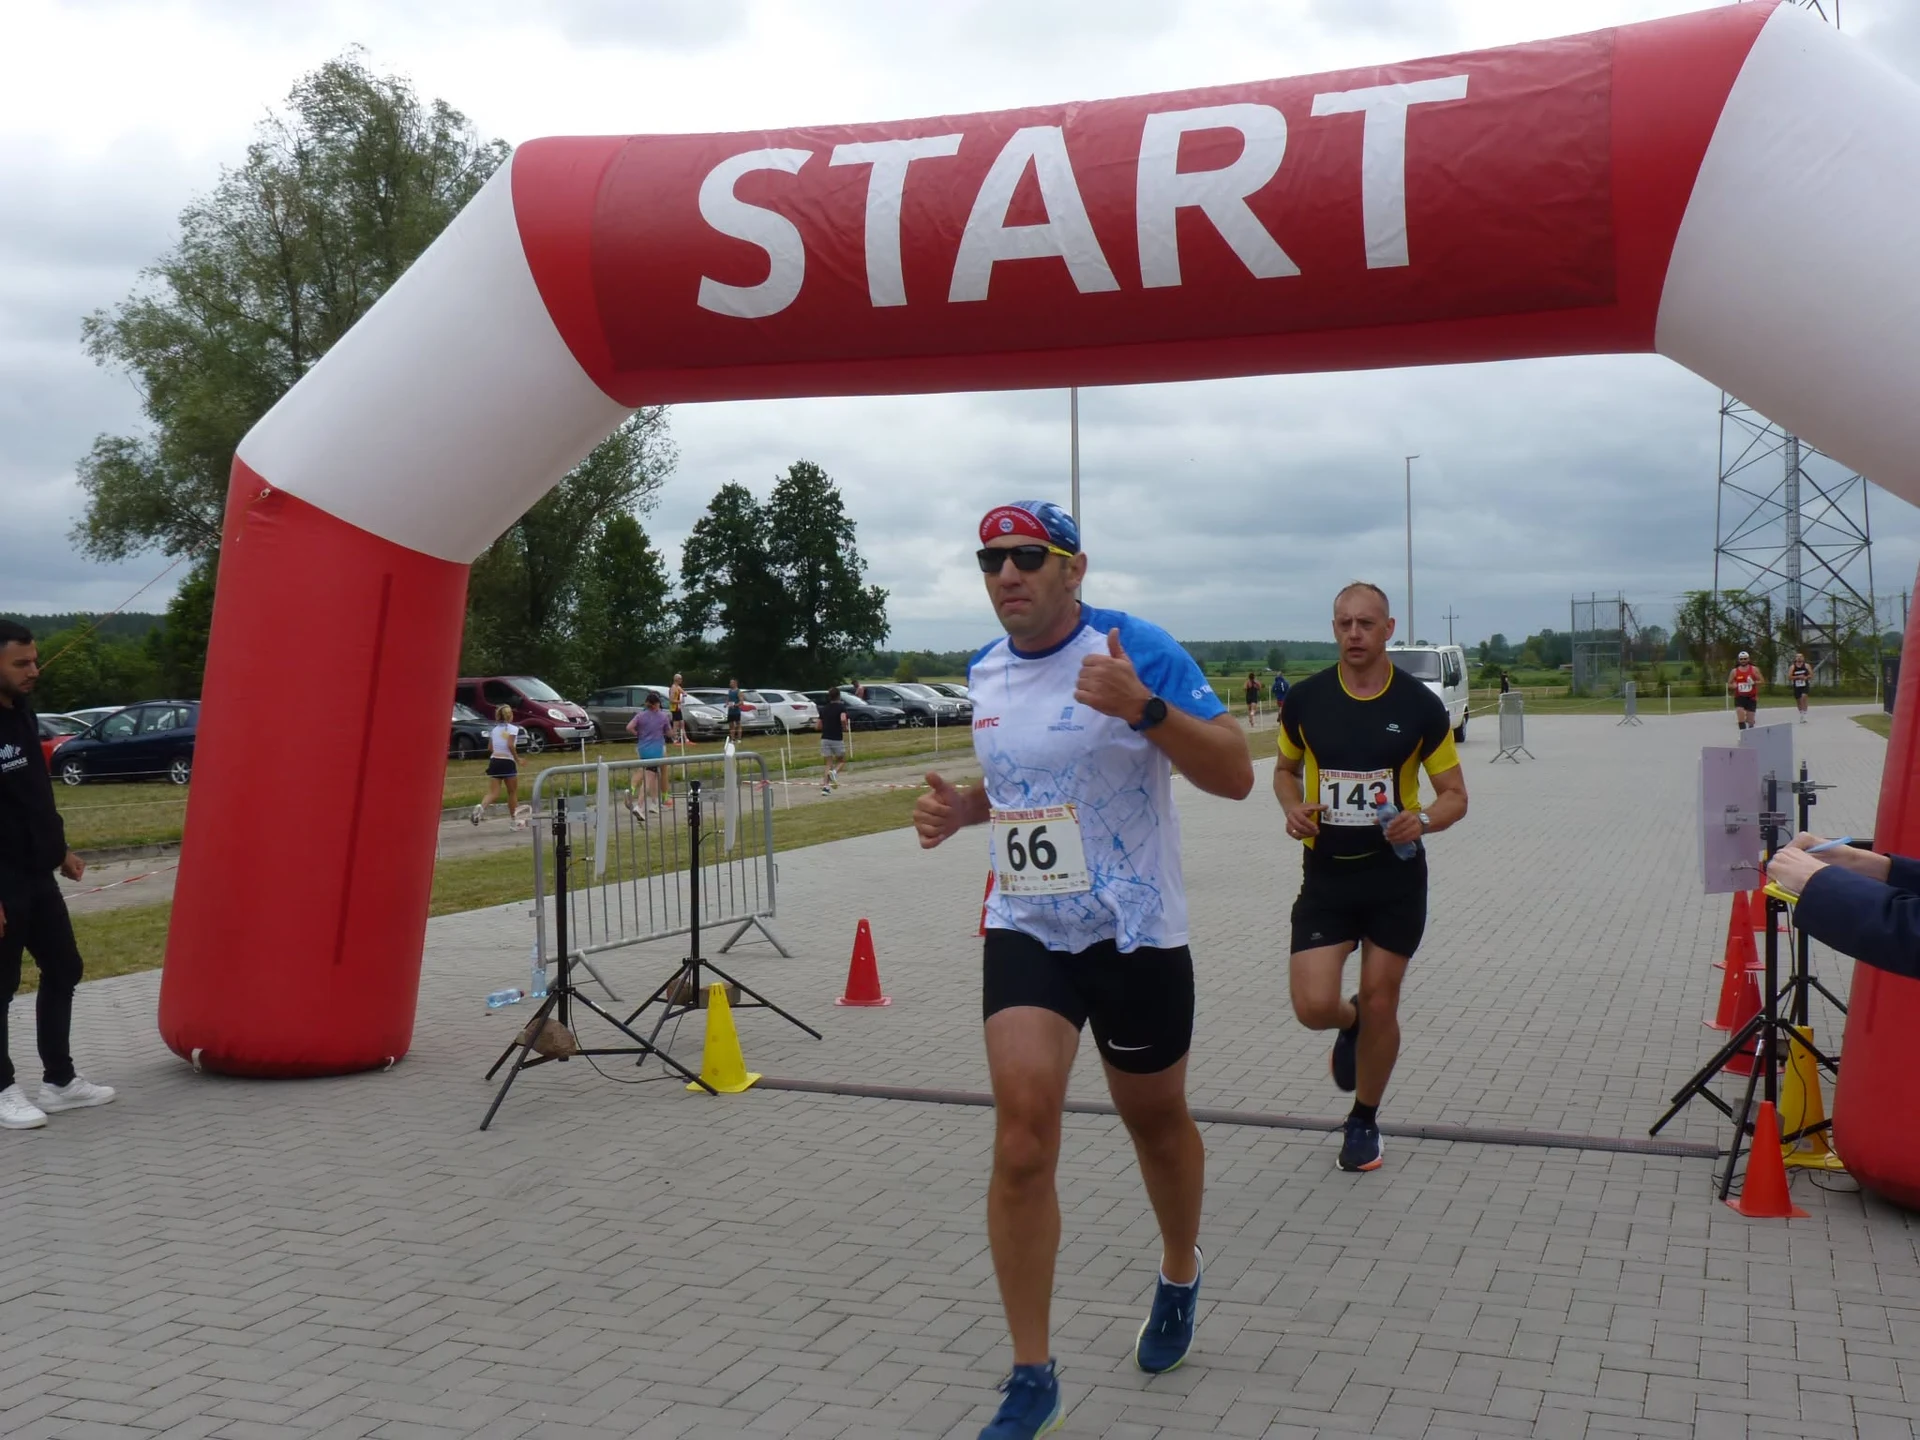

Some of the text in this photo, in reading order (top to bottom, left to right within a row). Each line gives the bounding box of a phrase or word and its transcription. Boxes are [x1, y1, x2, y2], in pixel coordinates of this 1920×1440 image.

[696, 74, 1469, 319] START
[1327, 781, 1387, 811] 143
[1007, 825, 1057, 872] 66
